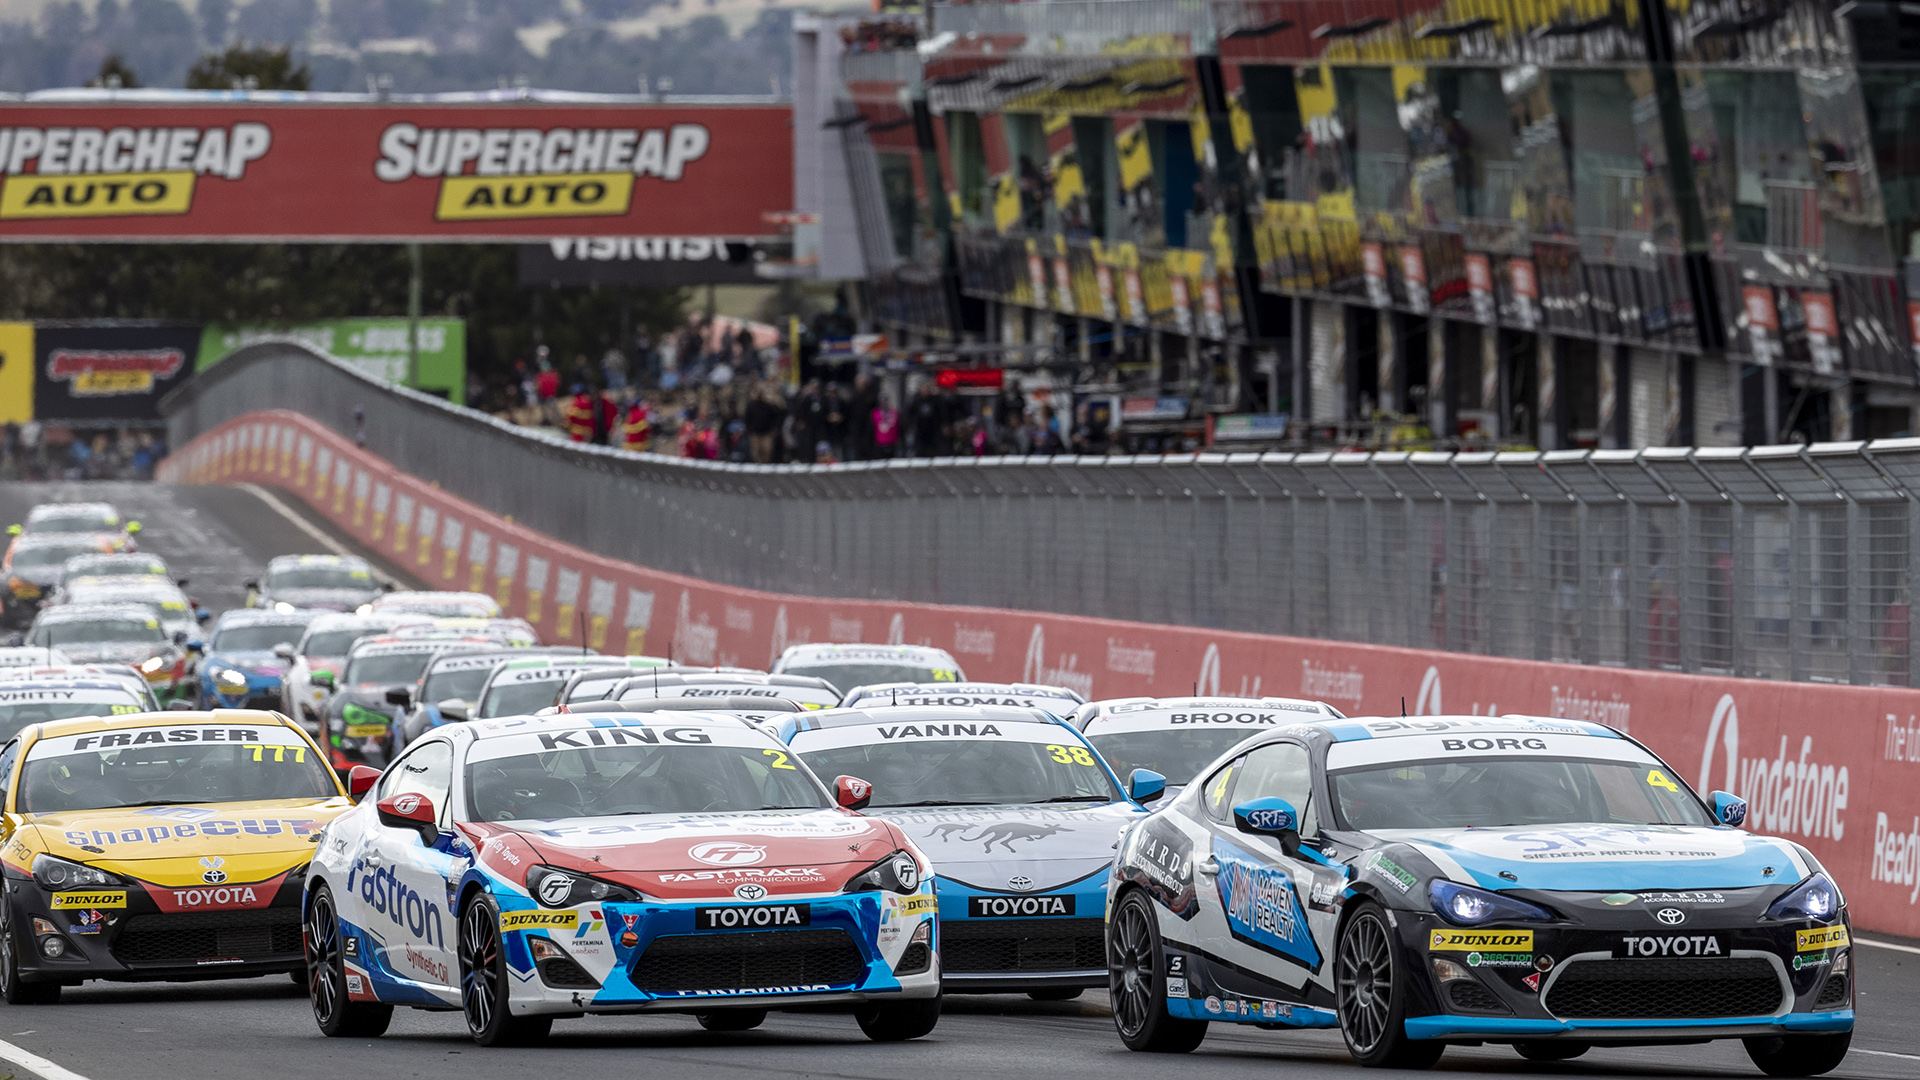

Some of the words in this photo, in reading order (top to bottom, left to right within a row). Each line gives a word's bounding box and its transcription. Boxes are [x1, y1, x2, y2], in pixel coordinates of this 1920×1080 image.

[375, 123, 709, 181] SUPERCHEAP
[25, 180, 169, 206] AUTO
[463, 181, 607, 209] AUTO
[870, 688, 948, 698] ROYAL
[959, 687, 1062, 698] MEDICAL
[903, 696, 1035, 707] THOMAS
[1170, 713, 1276, 725] BROOK
[73, 730, 259, 751] FRASER
[537, 728, 713, 750] KING
[877, 724, 1002, 739] VANNA
[1885, 714, 1906, 761] The
[243, 745, 306, 763] 777
[1441, 738, 1547, 750] BORG
[763, 750, 797, 770] 2
[1045, 745, 1095, 766] 38
[1212, 767, 1234, 806] 4
[1646, 770, 1679, 792] 4
[1741, 735, 1849, 841] vodafone
[540, 813, 853, 838] Fastron
[889, 811, 1004, 825] OURIST
[1022, 811, 1103, 822] PARK
[1251, 810, 1281, 827] SRT
[502, 845, 521, 866] Toyota
[1138, 830, 1189, 880] WARDS
[1522, 851, 1596, 860] SIEDERS
[658, 868, 822, 882] FASTTRACK
[717, 876, 826, 885] COMMUNICATIONS
[1378, 857, 1418, 887] REACTION
[1164, 874, 1184, 896] GROUP
[1257, 875, 1294, 916] MAVEN
[64, 895, 123, 904] DUNLOP
[174, 888, 257, 906] TOYOTA
[977, 897, 1066, 915] TOYOTA
[510, 914, 576, 925] DUNLOP
[706, 906, 801, 927] TOYOTA
[1256, 903, 1295, 943] REALTY
[1448, 935, 1530, 945] DUNLOP
[1623, 936, 1721, 957] TOYOTA
[1808, 930, 1847, 944] DUNLOP
[405, 942, 438, 978] Synthetic
[438, 964, 449, 985] Oil
[1482, 953, 1533, 961] REACTION
